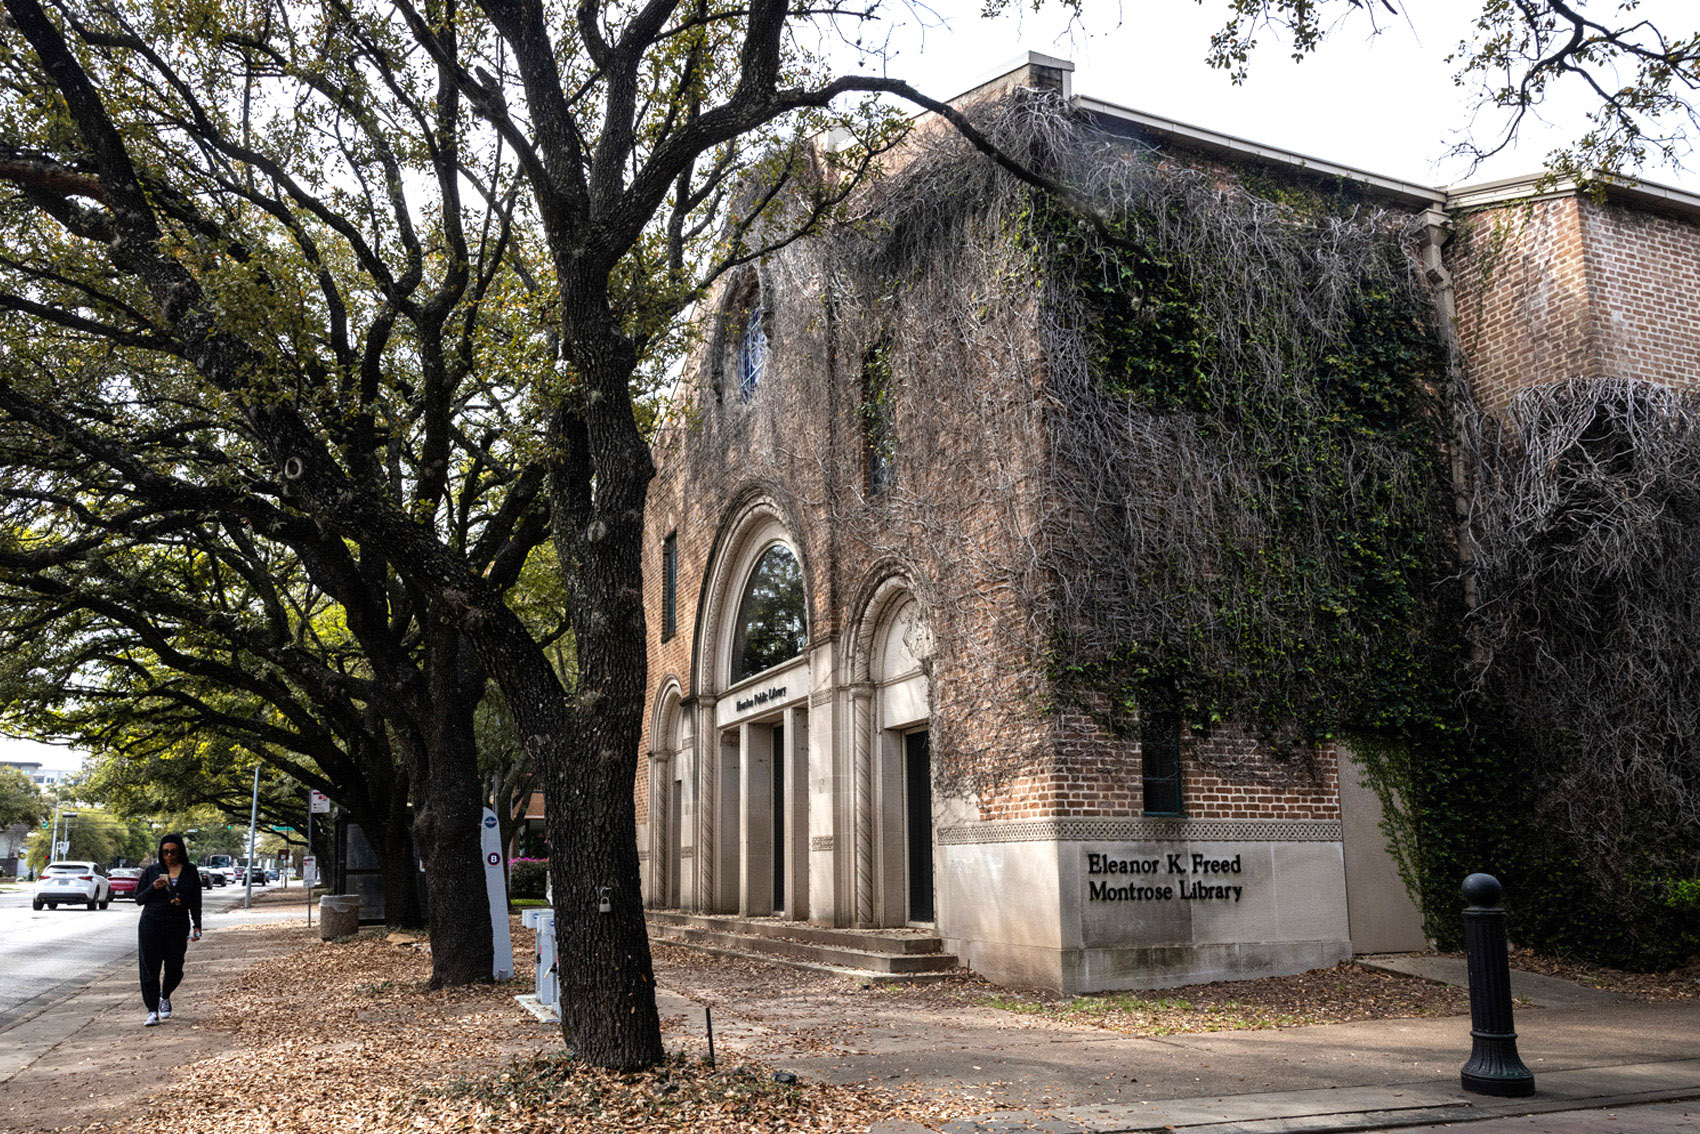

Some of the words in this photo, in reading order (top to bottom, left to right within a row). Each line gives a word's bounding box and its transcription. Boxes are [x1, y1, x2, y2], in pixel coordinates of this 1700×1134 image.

[754, 692, 769, 705] Public
[769, 687, 786, 700] Library
[1088, 853, 1160, 874] Eleanor
[1166, 853, 1186, 875] K.
[1191, 853, 1242, 874] Freed
[1089, 880, 1173, 901] Montrose
[1179, 879, 1243, 903] Library
